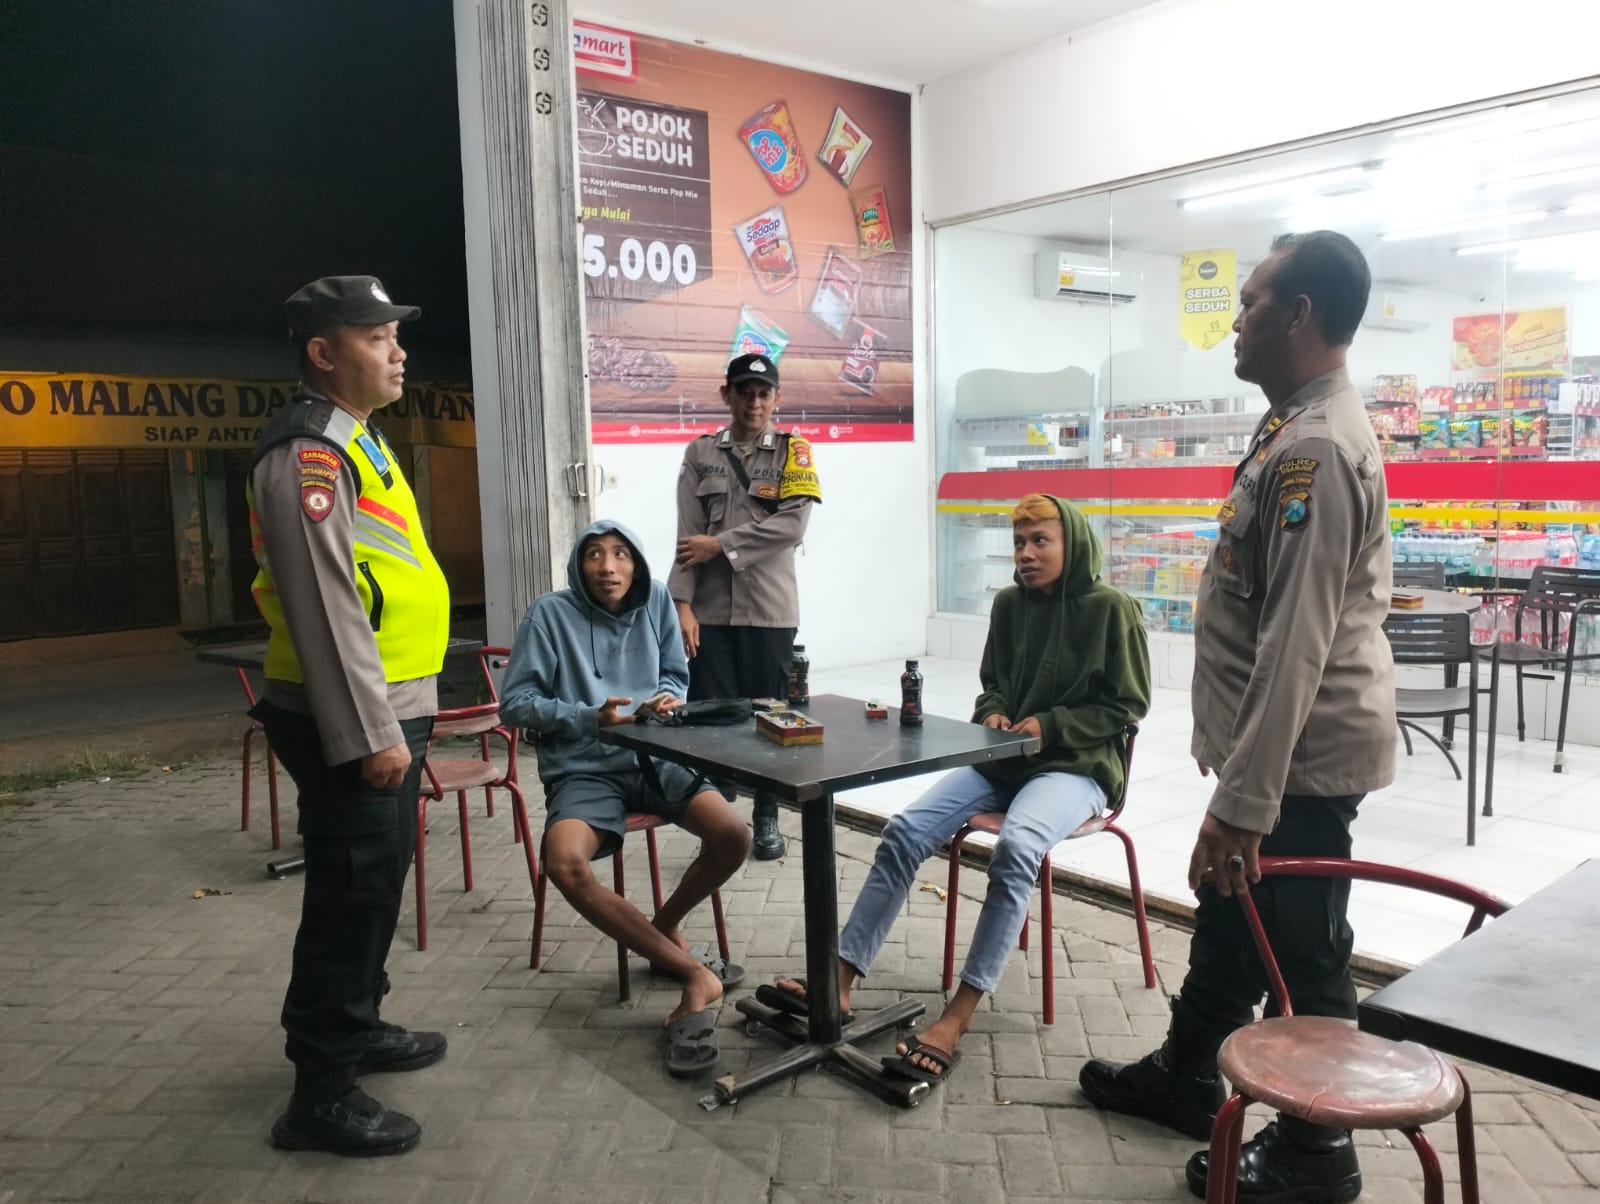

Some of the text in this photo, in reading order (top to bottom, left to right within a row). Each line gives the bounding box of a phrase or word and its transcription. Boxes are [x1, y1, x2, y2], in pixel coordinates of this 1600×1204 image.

[616, 106, 692, 140] POJOK
[617, 135, 693, 168] SEDUH
[590, 177, 647, 192] Kopi/Minuman
[648, 185, 668, 195] Serta
[670, 188, 683, 197] Pop
[685, 190, 698, 199] Mie
[600, 207, 631, 220] Mulai
[583, 234, 697, 285] 5.000
[1185, 287, 1230, 299] SERBA
[1184, 301, 1230, 313] SEDUH
[48, 380, 226, 418] MALANG
[235, 385, 298, 418] DA
[144, 426, 264, 442] SIAP ANTA
